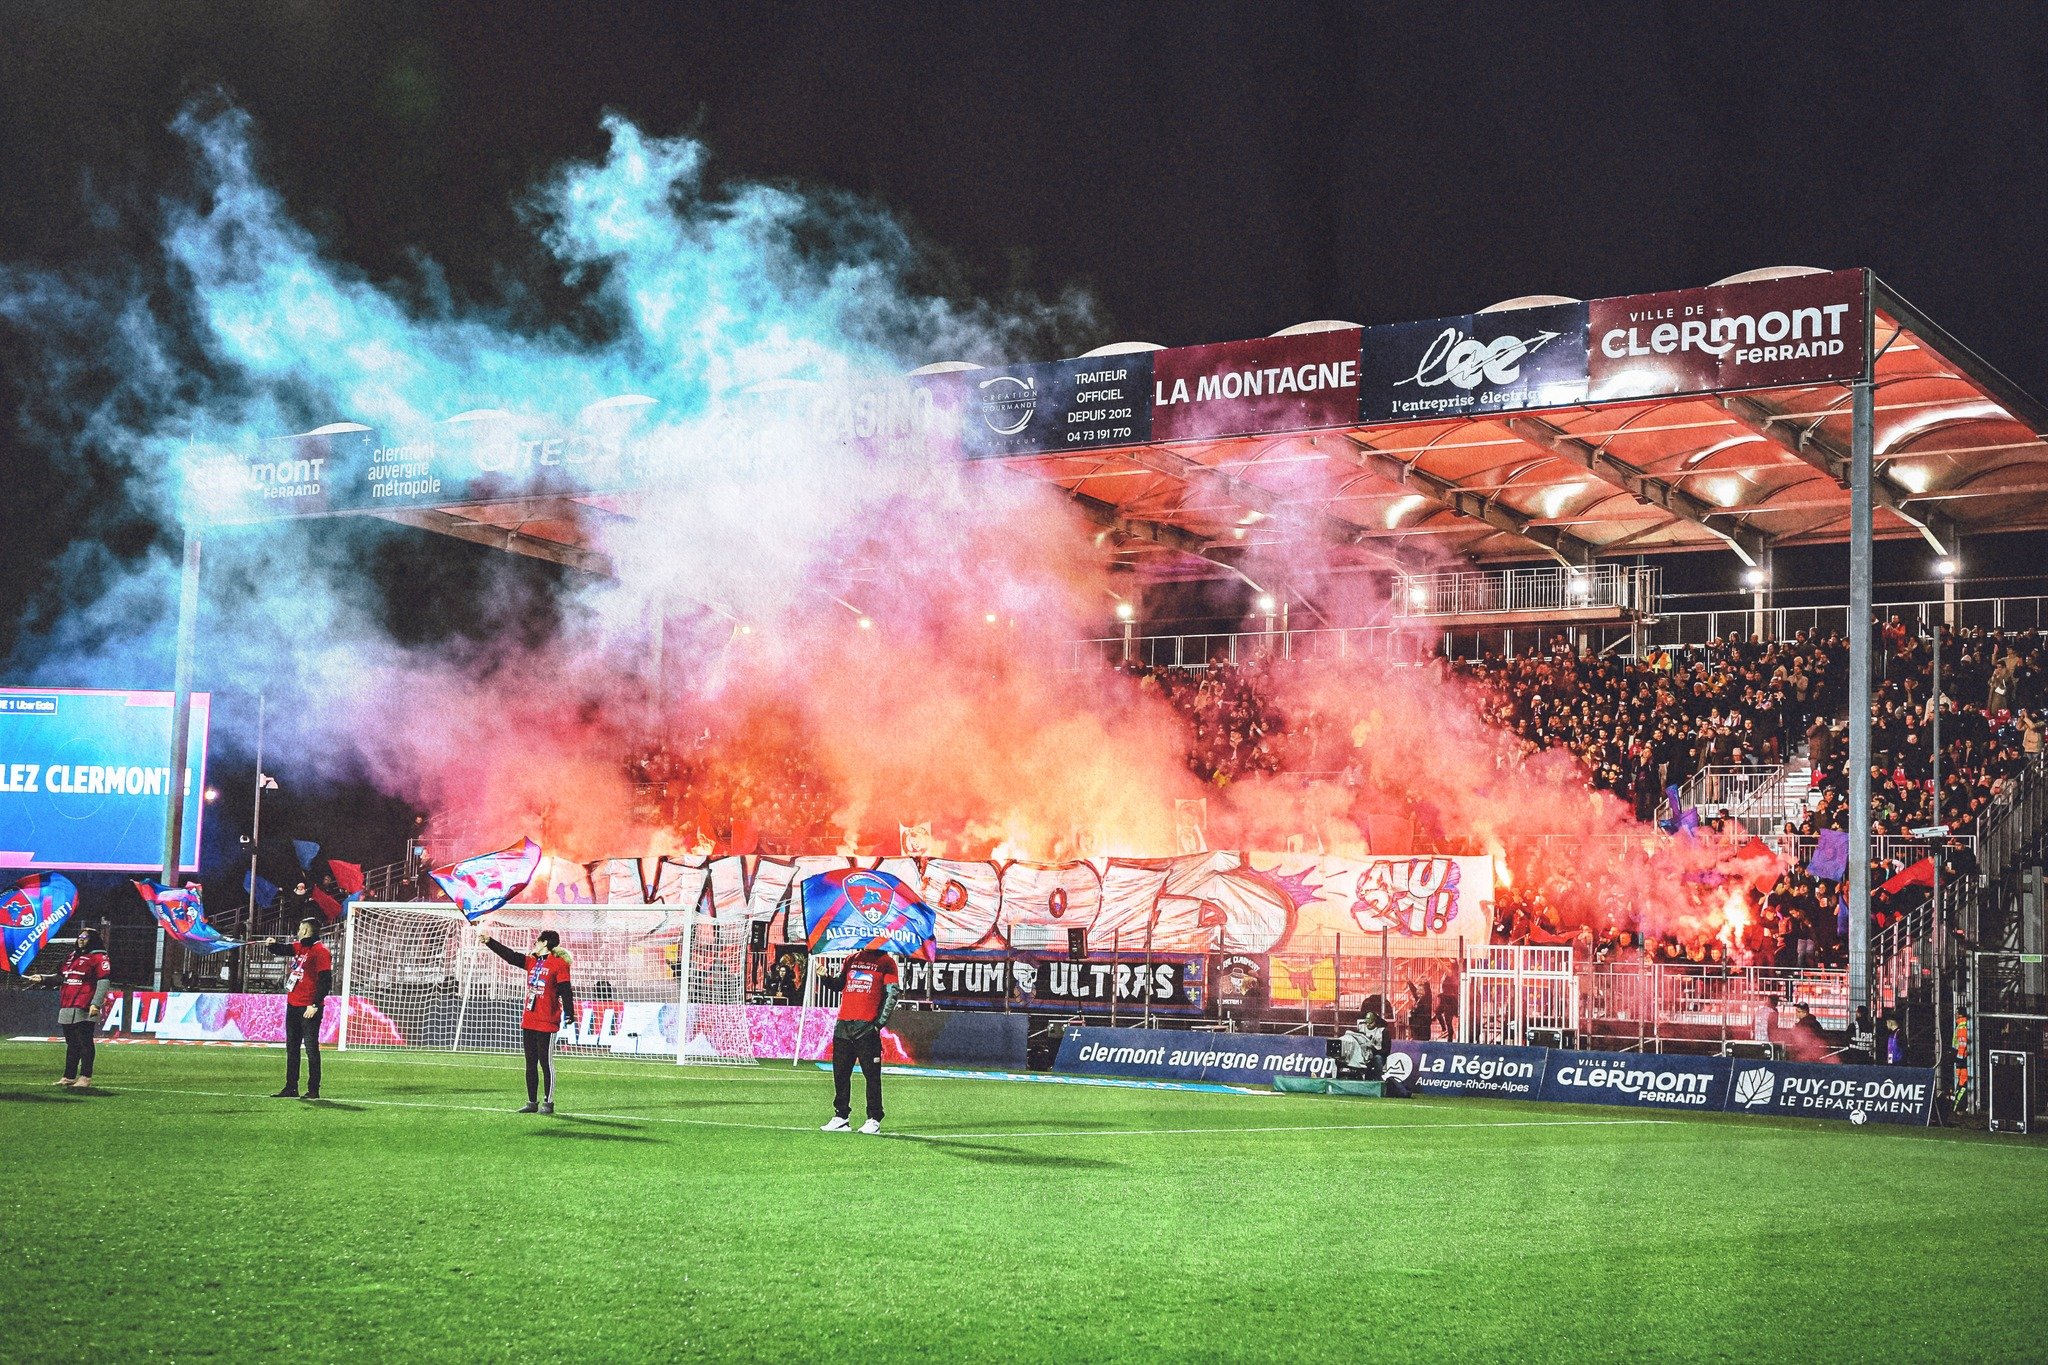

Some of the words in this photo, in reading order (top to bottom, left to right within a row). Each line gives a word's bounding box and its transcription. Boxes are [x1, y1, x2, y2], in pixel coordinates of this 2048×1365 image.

[1630, 310, 1674, 322] VILLE
[1684, 305, 1704, 316] DE
[1075, 369, 1127, 385] TRAITEUR
[1155, 378, 1189, 406] LA
[1196, 361, 1357, 403] MONTAGNE
[1076, 389, 1124, 404] OFFICIEL
[1392, 394, 1475, 413] l'entreprise
[982, 401, 1037, 413] GOURMANDE
[1067, 410, 1106, 423] DEPUIS
[1109, 408, 1132, 419] 2012
[1067, 432, 1080, 442] 04
[1083, 430, 1095, 440] 73
[1097, 429, 1110, 439] 191
[1113, 427, 1131, 438] 770
[368, 462, 430, 480] auvergne
[372, 477, 441, 500] métropole
[45, 766, 171, 795] CLERMONT
[867, 911, 879, 919] 63
[9, 940, 32, 965] ALLEZ
[27, 905, 68, 942] CLERMONT
[826, 926, 858, 941] ALLEZ
[859, 928, 916, 944] CLERMONT
[896, 962, 1006, 992] EMETUM
[1050, 963, 1175, 999] ULTRAS
[1079, 1041, 1165, 1066] clermont
[1168, 1050, 1259, 1069] auvergne
[1263, 1052, 1334, 1077] métrop
[1418, 1053, 1446, 1073] La
[1452, 1055, 1533, 1079] Région
[1578, 1058, 1607, 1067] VILLE
[1613, 1060, 1627, 1069] DE
[1416, 1075, 1529, 1093] Auvergne-Rhône-Alpes
[1782, 1077, 1926, 1102] PUY-DE-DÔME
[1780, 1095, 1799, 1107] LE
[1803, 1095, 1924, 1115] DÉPARTEMENT
